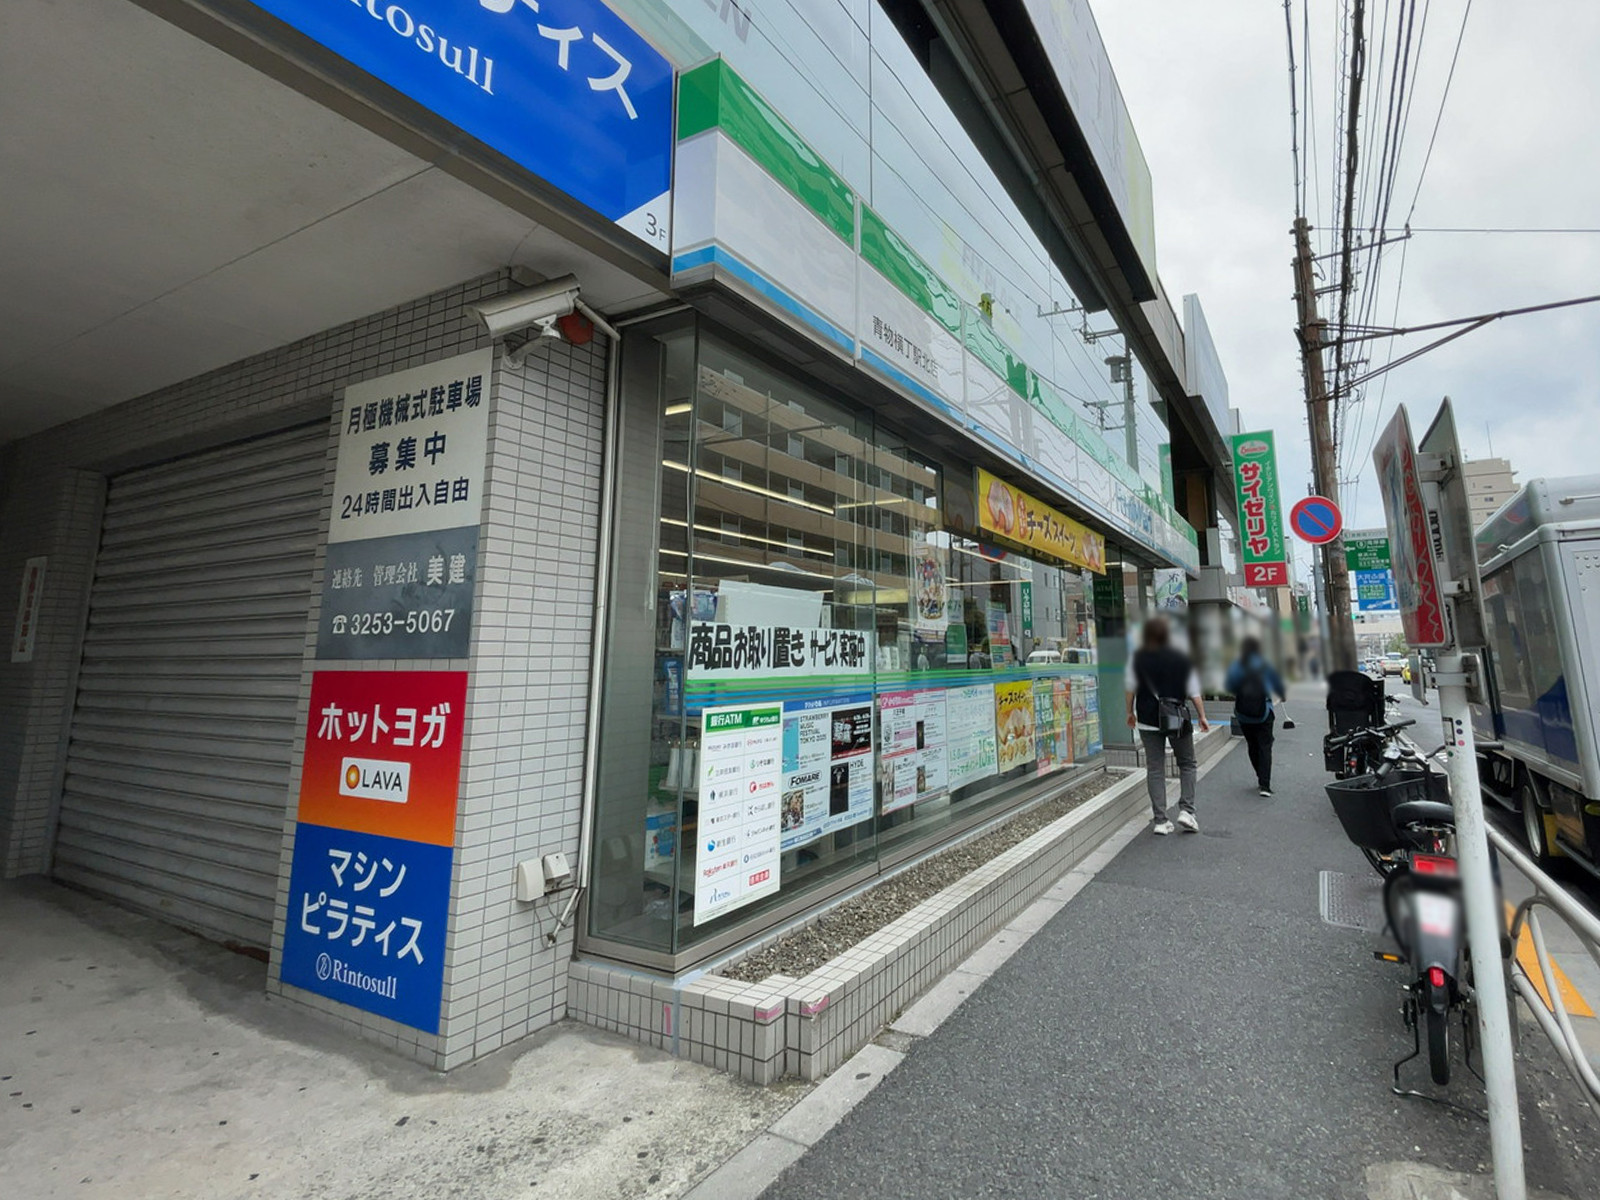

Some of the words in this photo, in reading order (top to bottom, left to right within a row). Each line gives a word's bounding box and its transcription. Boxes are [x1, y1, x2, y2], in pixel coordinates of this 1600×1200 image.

[352, 0, 494, 96] tosull
[478, 0, 640, 121] ィス
[645, 212, 667, 241] 3F
[346, 375, 483, 435] 月極機械式駐車場
[368, 430, 447, 476] 募集中
[340, 476, 470, 519] 24時間出入自由
[1239, 460, 1270, 557] サイゼリヤ
[331, 567, 363, 590] 連絡先
[373, 562, 418, 587] 管理会社
[426, 554, 466, 586] 美建
[1254, 566, 1278, 581] 2F
[351, 609, 455, 635] 3253-5067
[688, 622, 805, 670] 商品お取り置き
[810, 630, 866, 668] サービス実施中
[317, 702, 451, 749] ホットヨガ
[362, 769, 403, 793] LAVA
[790, 772, 820, 787] FOMARE
[328, 849, 407, 897] マシン
[301, 891, 424, 966] ピラティス
[332, 958, 397, 1000] Rintosull
